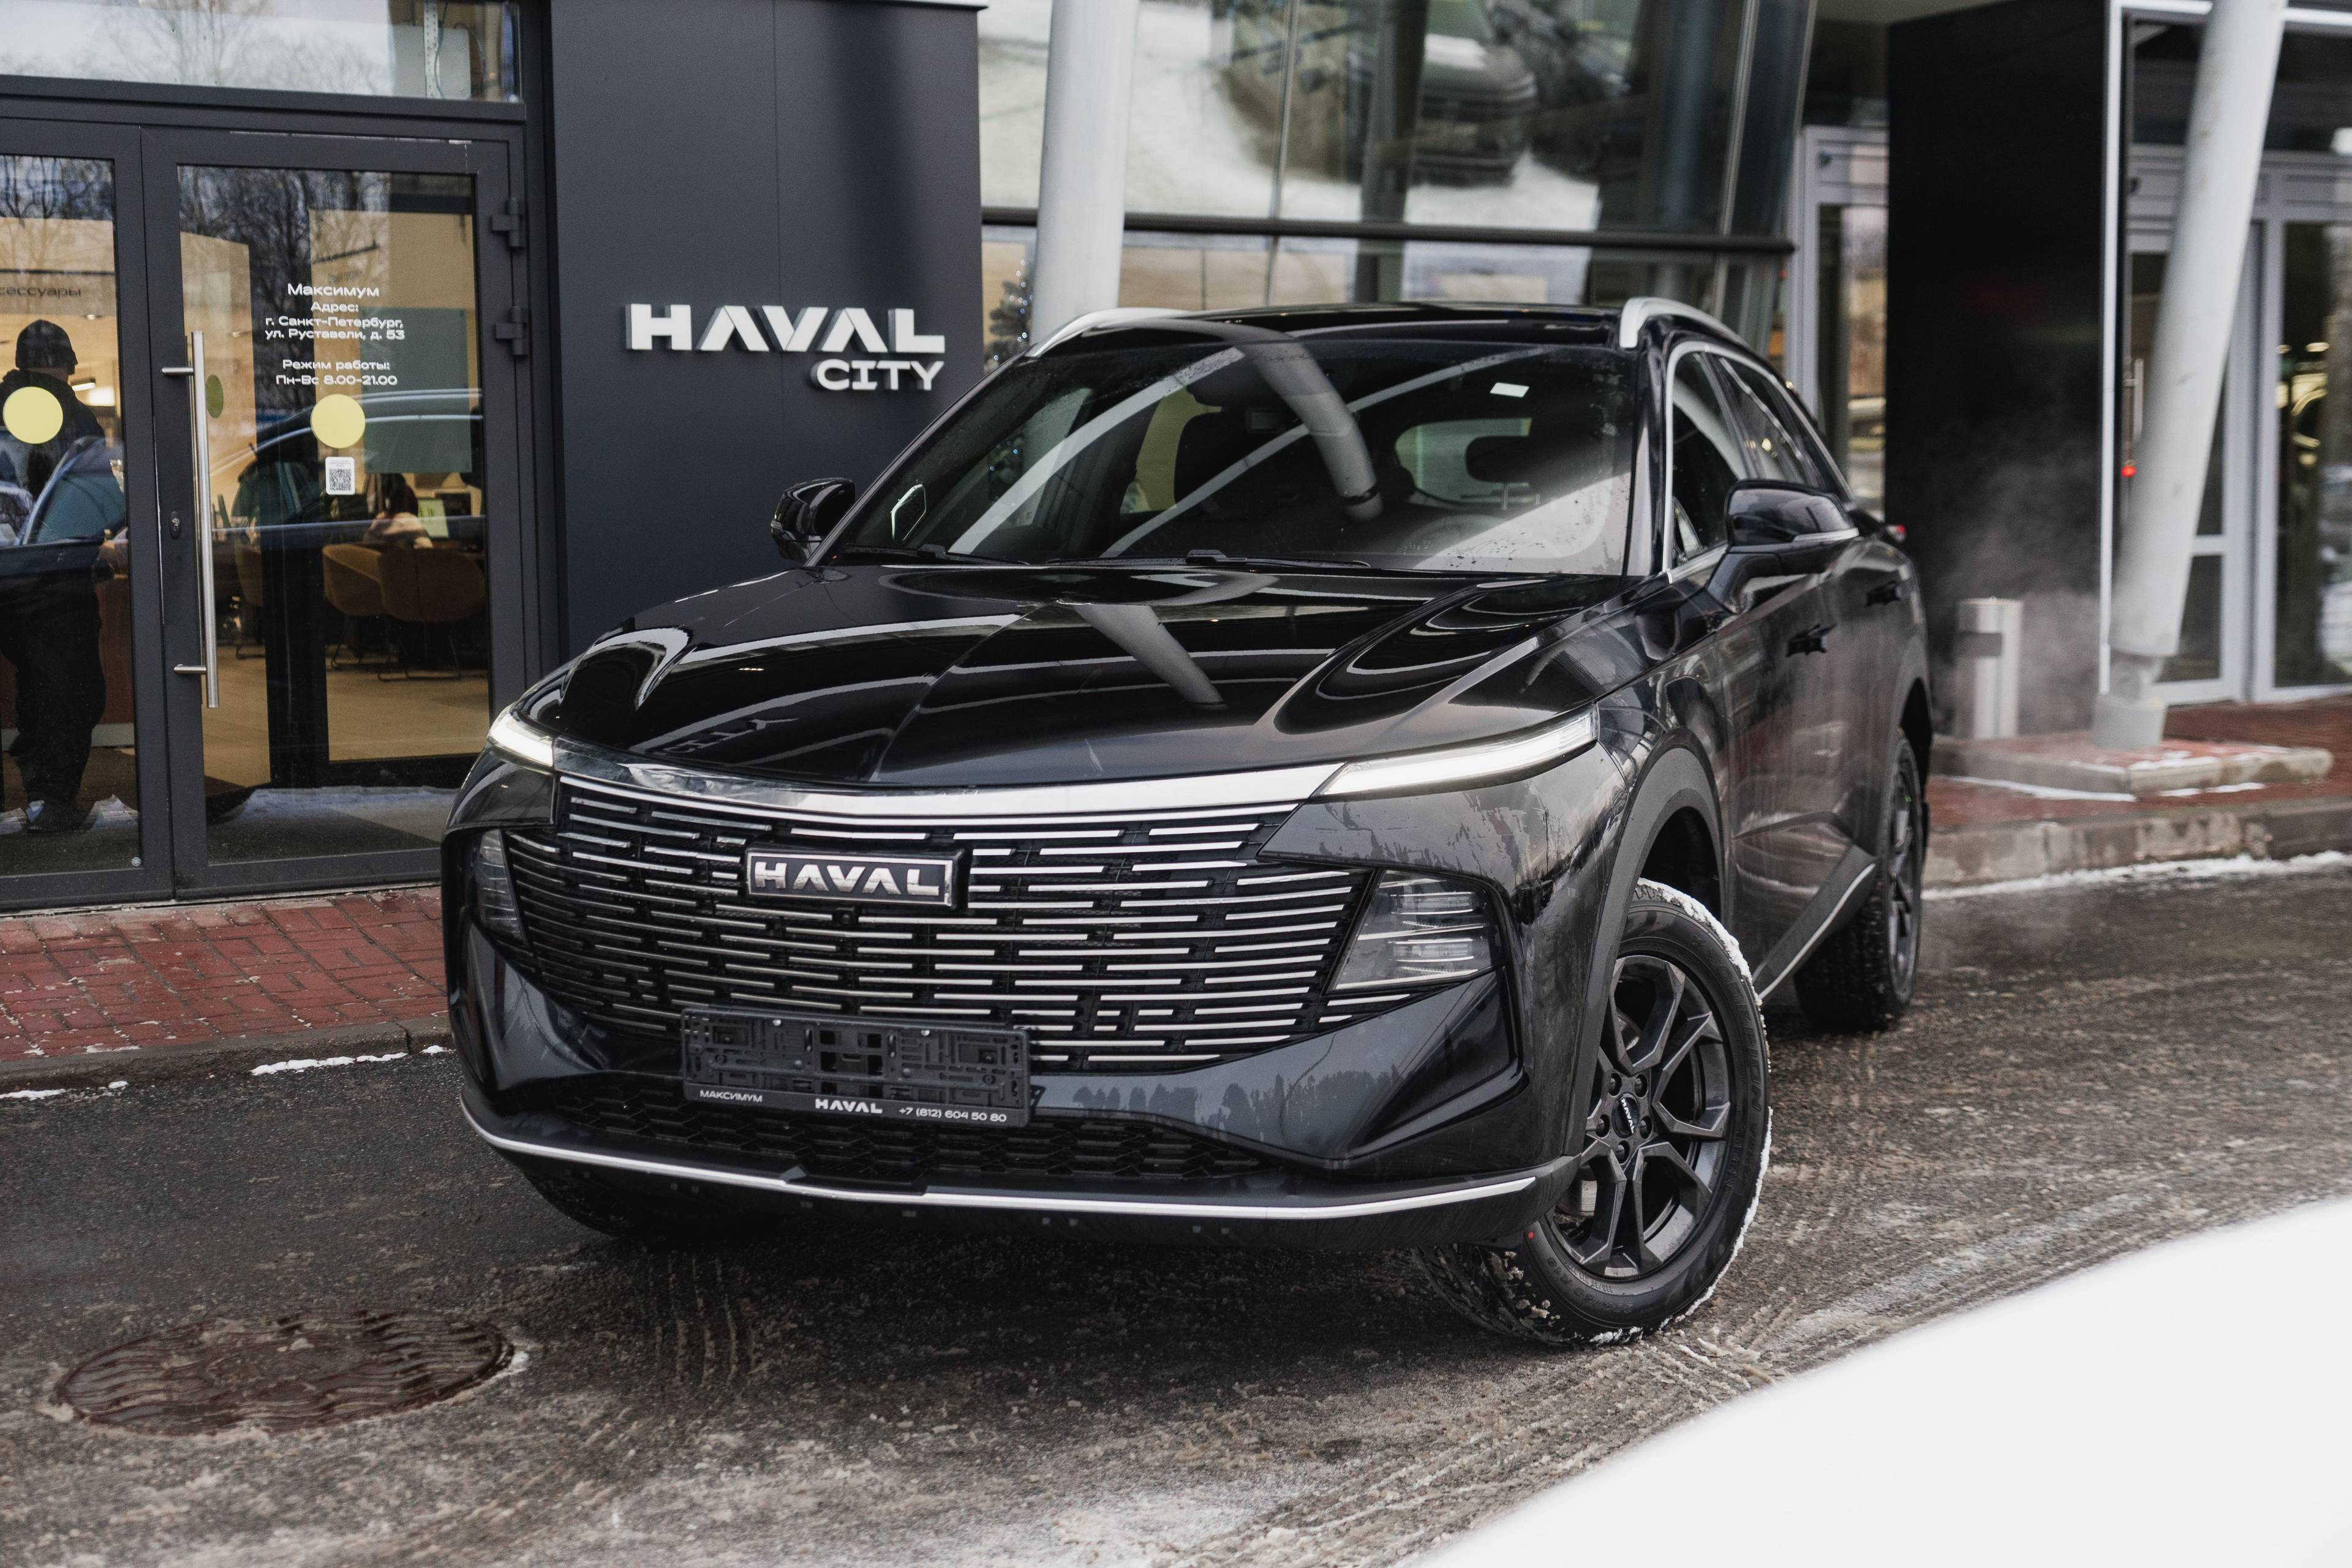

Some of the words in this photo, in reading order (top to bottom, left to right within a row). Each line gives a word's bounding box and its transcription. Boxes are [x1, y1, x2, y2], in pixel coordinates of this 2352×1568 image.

[287, 283, 380, 299] Максимум
[311, 301, 360, 314] Адрес:
[265, 317, 275, 326] г.
[278, 315, 404, 330] Санкт-Петербург,
[626, 303, 945, 353] HAVAL
[265, 330, 285, 341] ул.
[288, 328, 367, 341] Руставели,
[370, 330, 382, 341] д.
[386, 329, 405, 340] 53
[282, 359, 331, 371] Режим
[336, 359, 391, 372] работы:
[276, 374, 319, 386] Пн-Вс
[323, 374, 398, 386] 8.00-21.00
[812, 358, 944, 390] CITY
[755, 861, 940, 896] HAVAL
[699, 1090, 763, 1103] МАКСИМУМ
[815, 1098, 883, 1114] HAVAL
[916, 1107, 942, 1119] (812)
[944, 1110, 968, 1120] 604
[971, 1112, 987, 1121] 50
[990, 1114, 1008, 1123] 80
